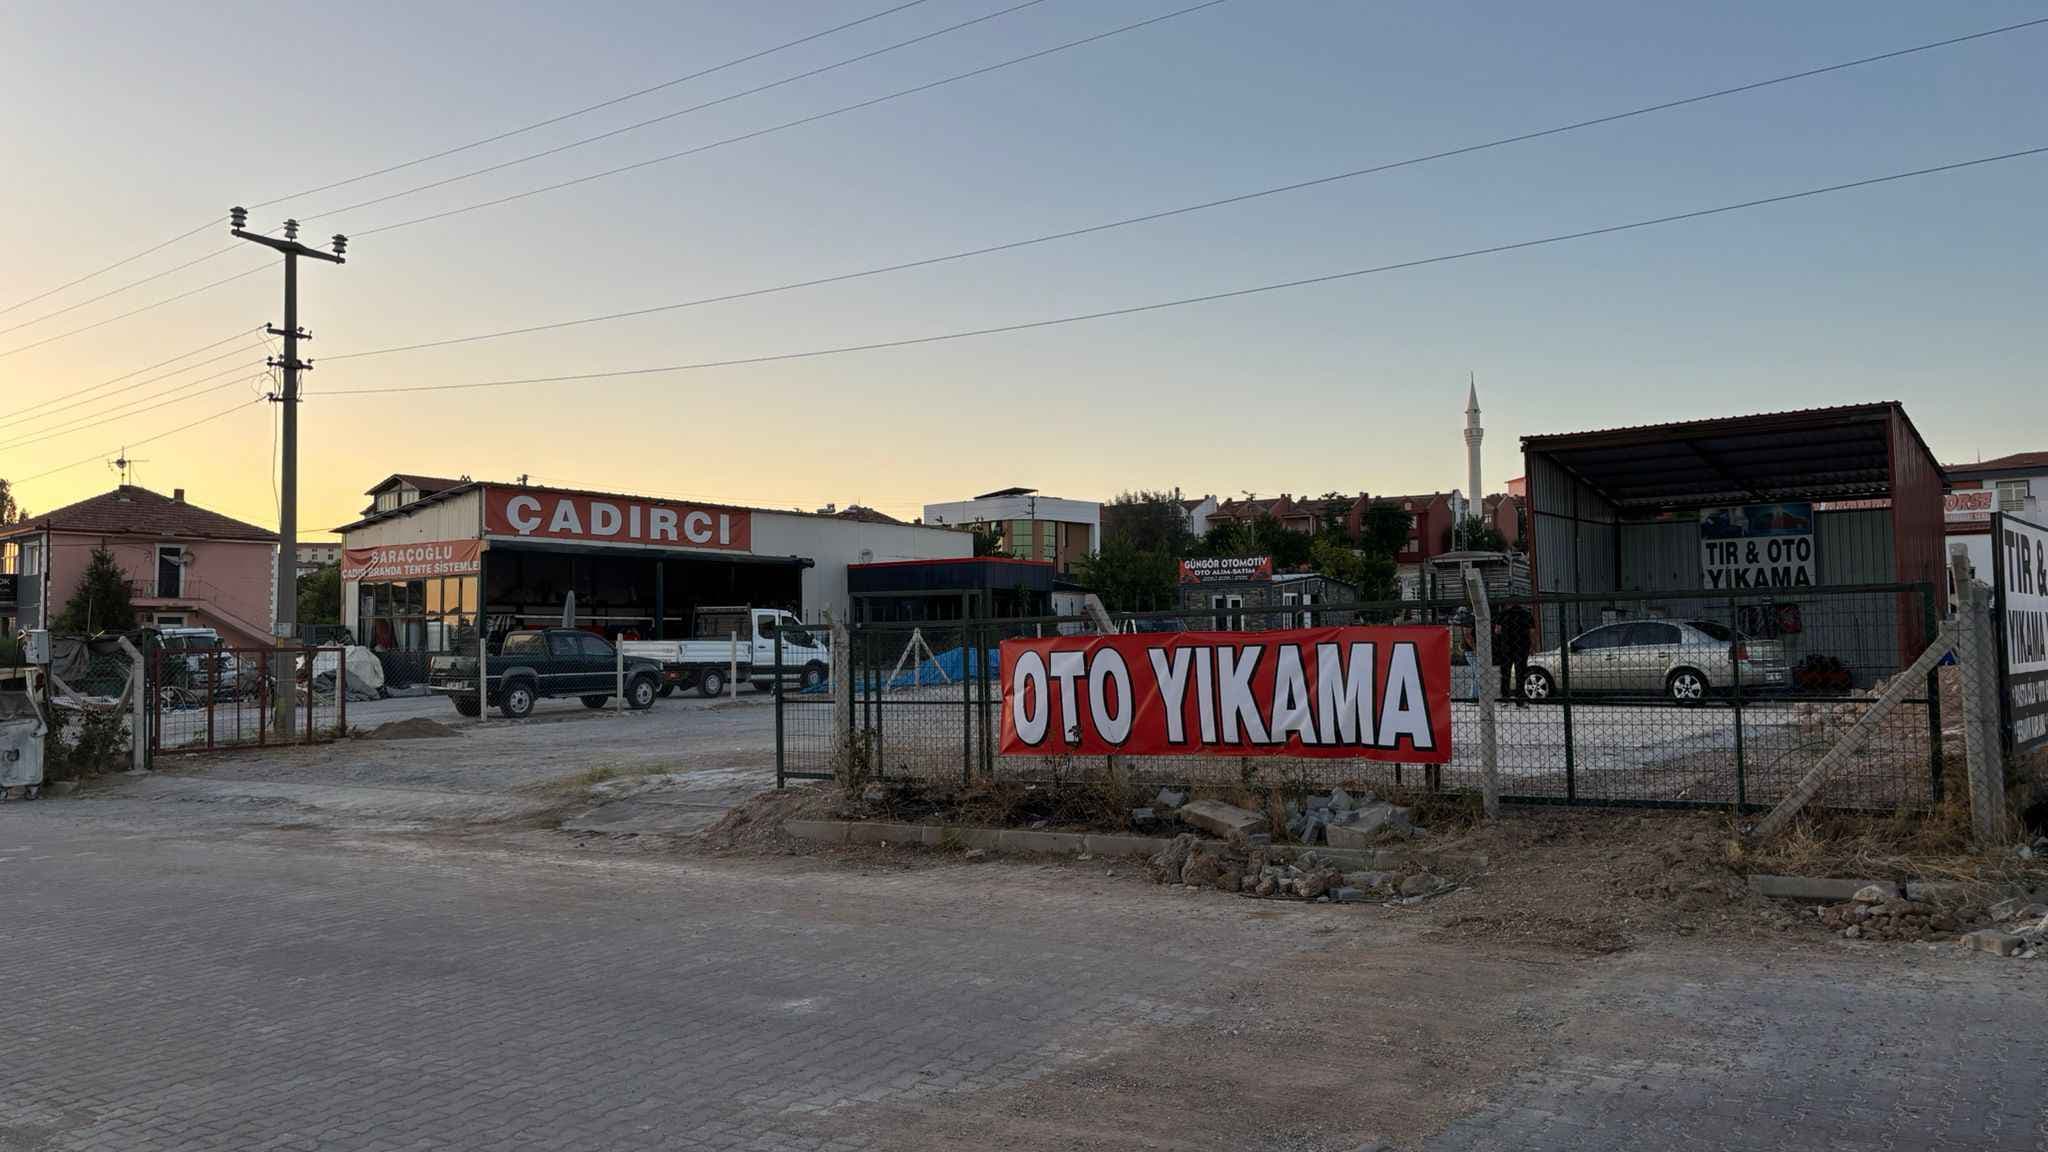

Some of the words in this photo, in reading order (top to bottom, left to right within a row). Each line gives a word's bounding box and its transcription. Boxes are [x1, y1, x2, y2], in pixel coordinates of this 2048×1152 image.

[506, 494, 730, 545] ÇADIRCI
[371, 544, 453, 564] SARAÇOĞLU
[1184, 557, 1219, 569] GÜNGÖR
[1221, 555, 1267, 568] OTOMOTİV
[1705, 541, 1739, 566] TIR
[1745, 540, 1760, 564] &
[1767, 537, 1811, 563] OTO
[2004, 529, 2034, 595] TIR
[2036, 538, 2048, 598] &
[404, 563, 431, 575] TENTE
[434, 560, 481, 573] SİSTEMLE
[1707, 566, 1811, 589] YIKAMA
[2008, 610, 2046, 665] YIKAMA
[1012, 646, 1134, 747] OTO
[1147, 641, 1437, 750] YIKAMA
